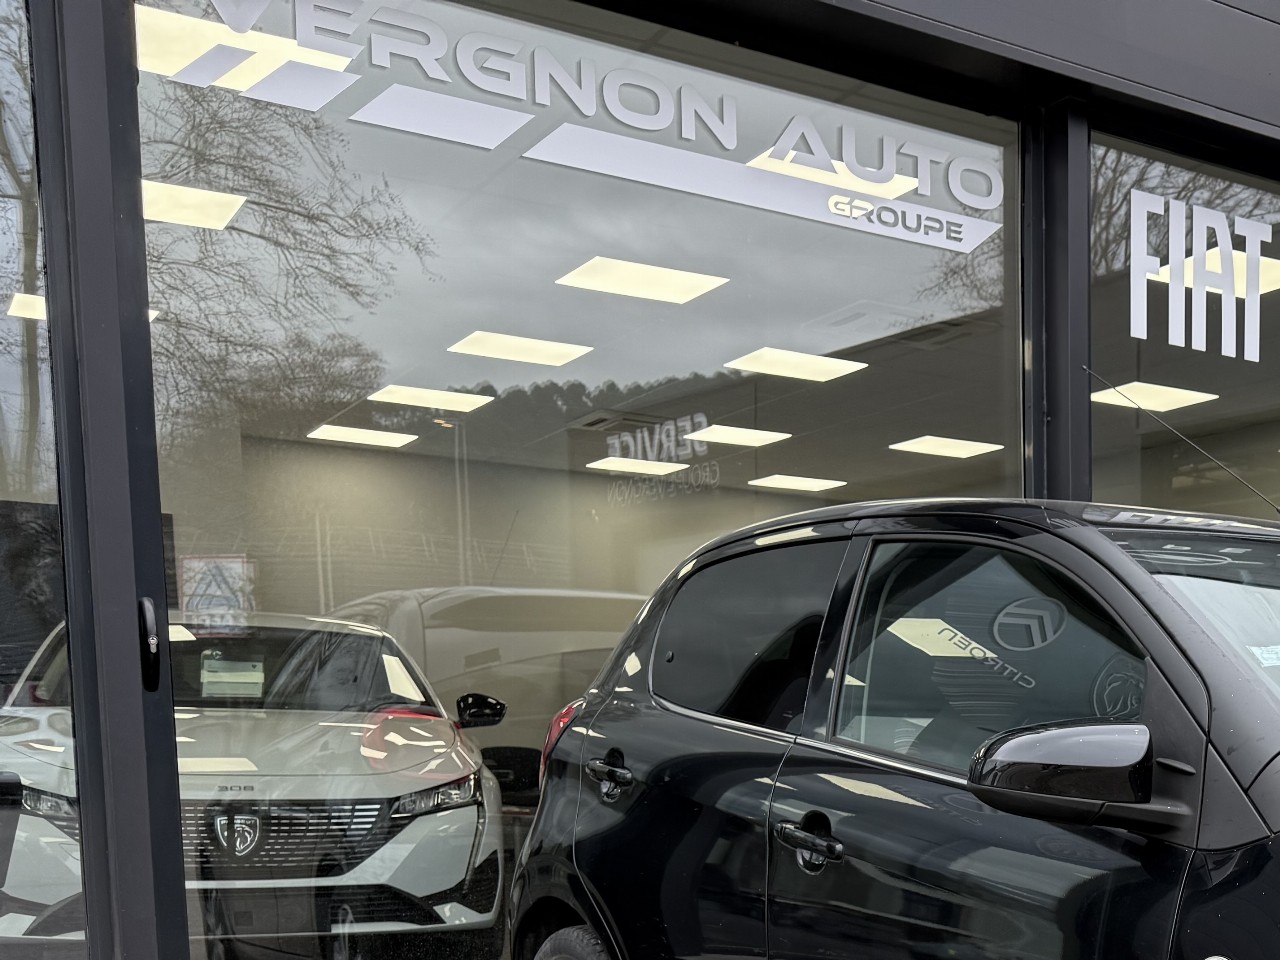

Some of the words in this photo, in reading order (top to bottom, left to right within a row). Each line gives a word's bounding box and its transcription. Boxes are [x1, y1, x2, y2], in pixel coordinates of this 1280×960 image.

[210, 0, 737, 151] VERGNON
[763, 114, 1004, 210] AUTO
[827, 194, 963, 244] GROUPE
[1130, 189, 1273, 362] FIAT
